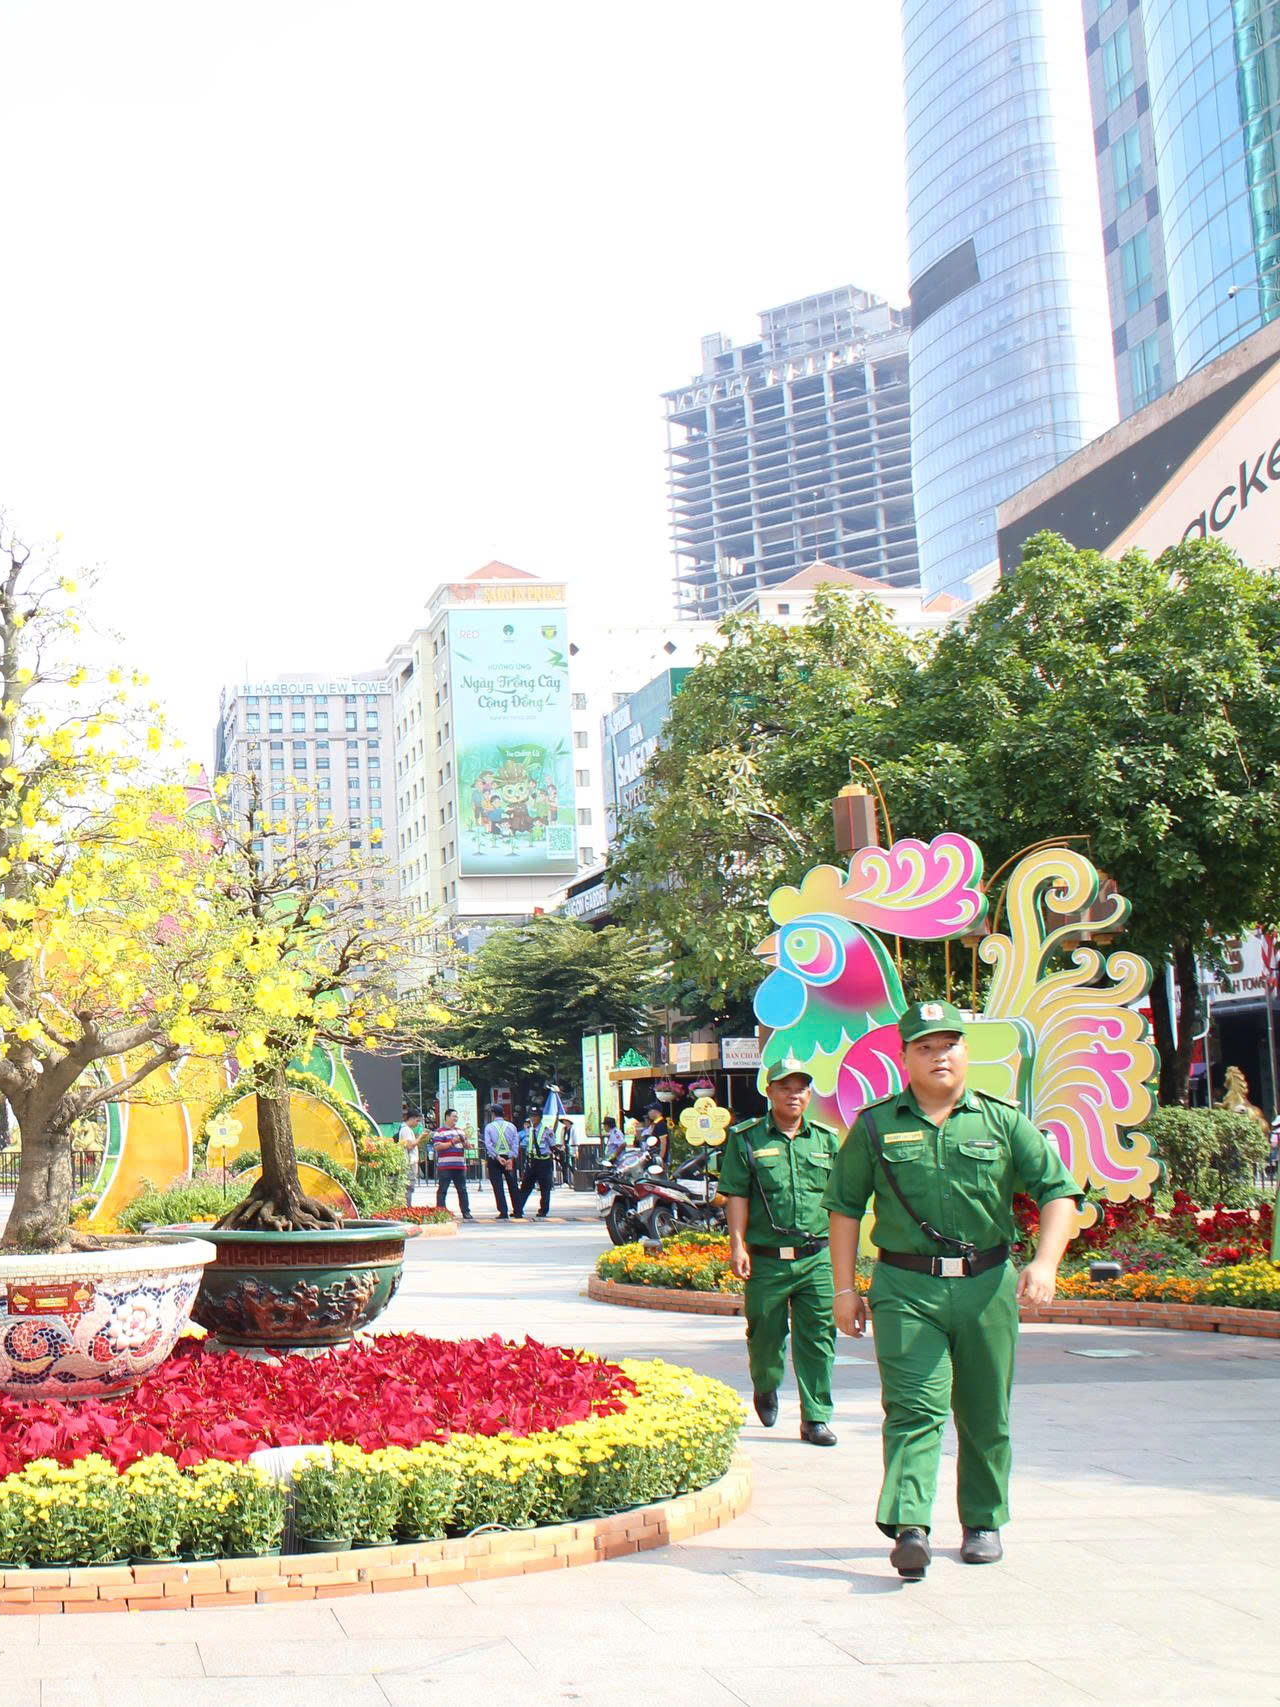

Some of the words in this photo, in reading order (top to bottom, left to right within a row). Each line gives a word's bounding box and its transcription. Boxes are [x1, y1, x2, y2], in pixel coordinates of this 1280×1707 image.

[255, 683, 314, 694] HARBOUR
[318, 683, 348, 693] VIEW
[460, 675, 494, 693] Ngày
[497, 673, 535, 694] Trồng
[538, 674, 561, 693] Cây
[478, 694, 508, 713] Cộng
[512, 693, 544, 713] Đồng
